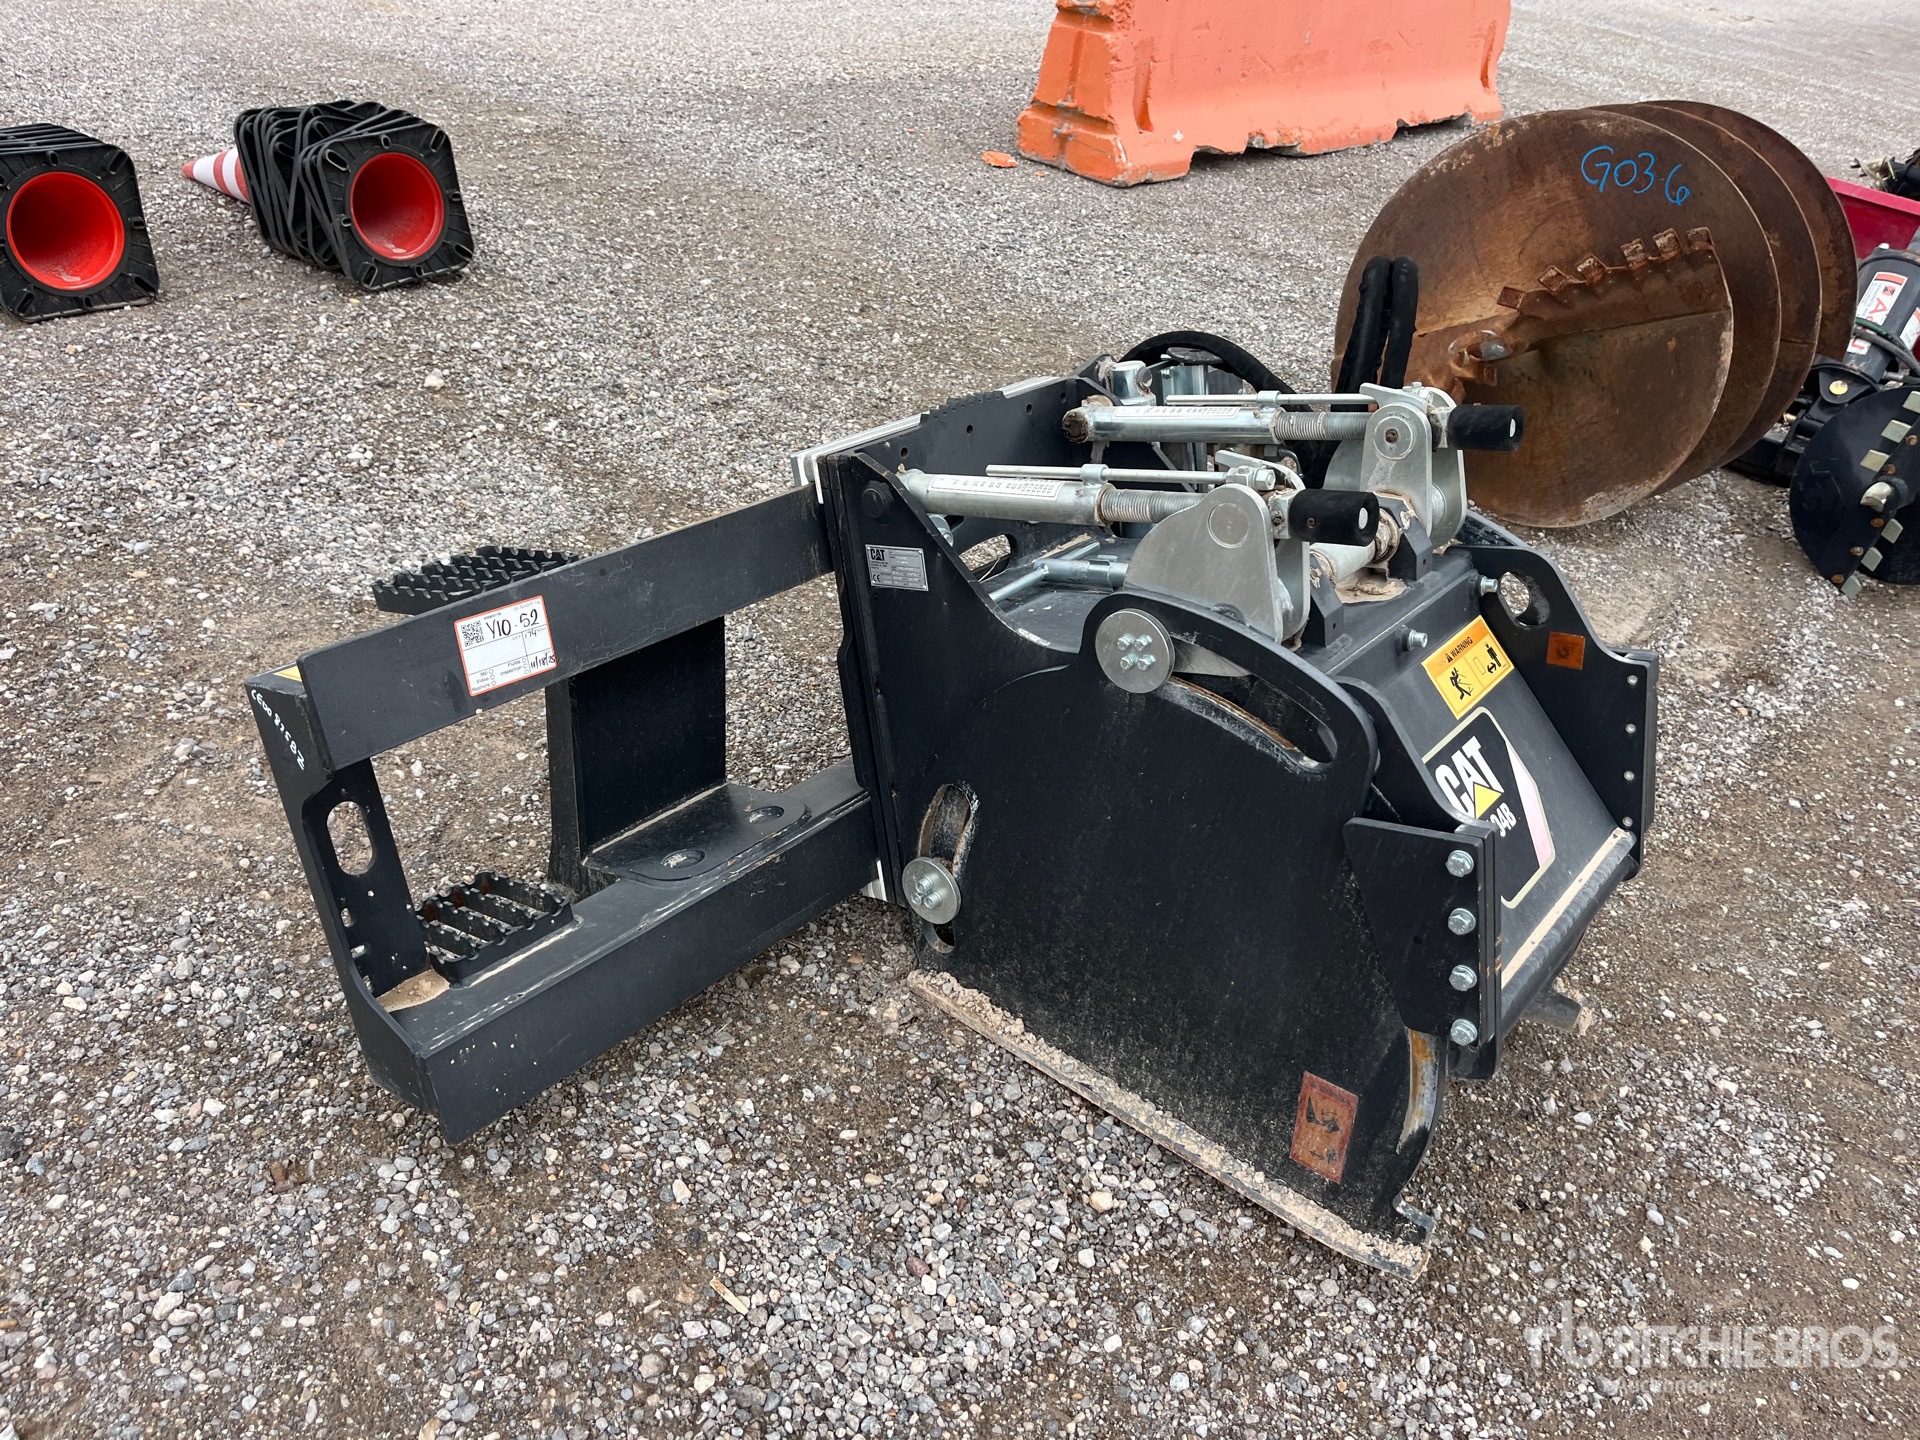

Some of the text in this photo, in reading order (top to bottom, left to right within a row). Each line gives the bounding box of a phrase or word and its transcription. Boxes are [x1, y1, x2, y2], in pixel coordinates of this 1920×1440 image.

[1581, 144, 1691, 206] G036
[870, 548, 885, 561] CAT
[1450, 636, 1474, 658] WARNING
[1435, 735, 1504, 819] CAT
